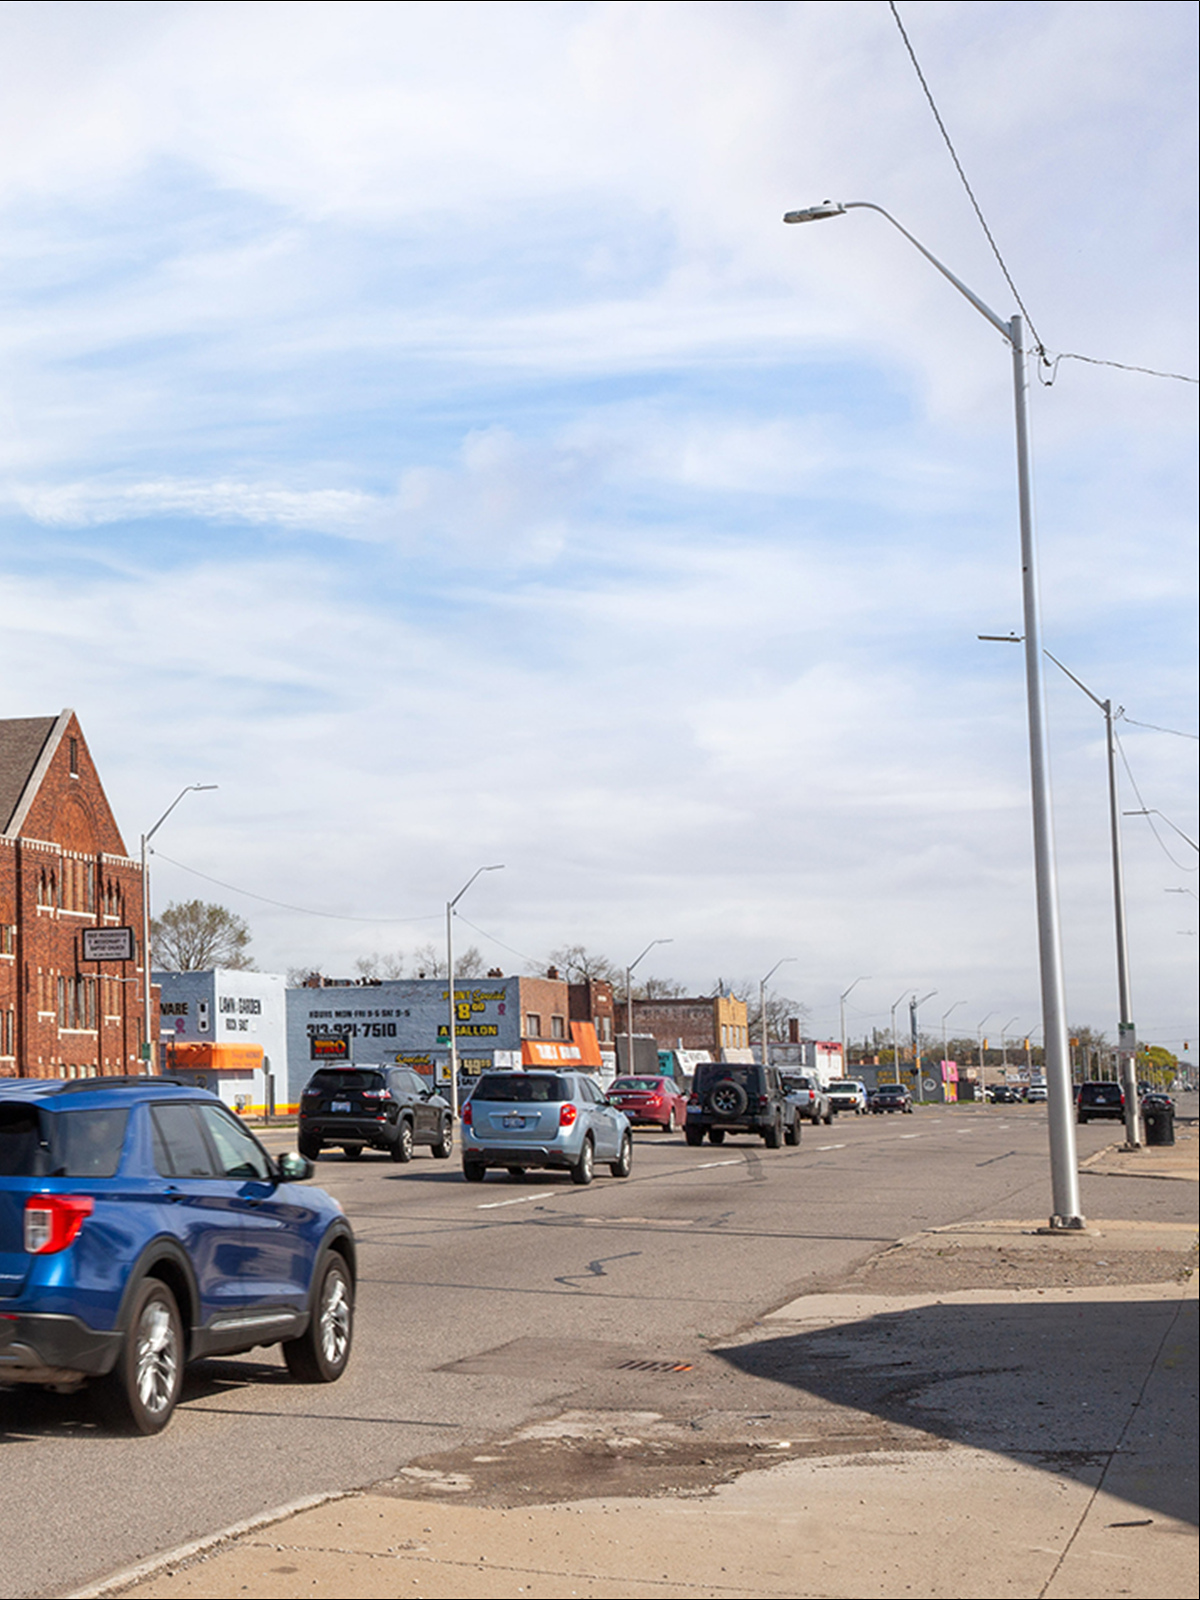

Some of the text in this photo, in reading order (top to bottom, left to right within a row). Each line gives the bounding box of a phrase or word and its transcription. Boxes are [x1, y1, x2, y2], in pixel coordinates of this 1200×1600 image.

[219, 996, 235, 1014] LAWN
[239, 997, 262, 1015] GARDEN
[440, 1025, 498, 1036] A GALLON
[314, 1039, 347, 1054] PRO
